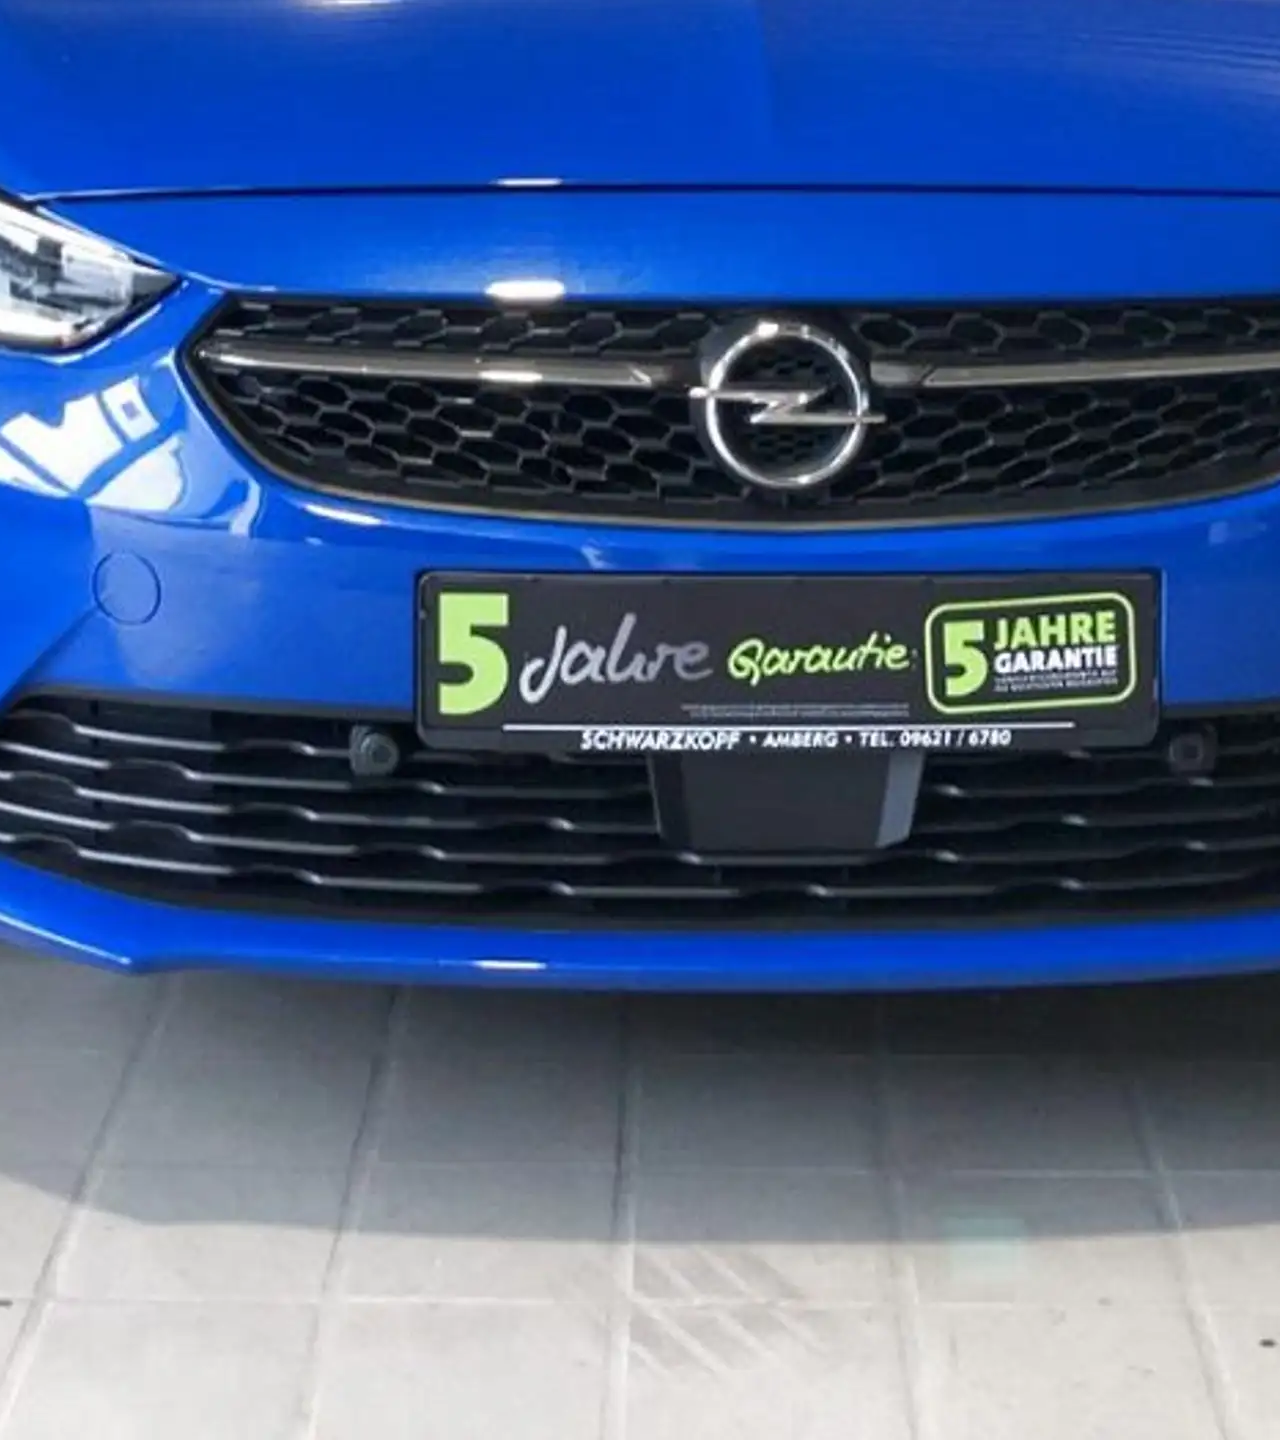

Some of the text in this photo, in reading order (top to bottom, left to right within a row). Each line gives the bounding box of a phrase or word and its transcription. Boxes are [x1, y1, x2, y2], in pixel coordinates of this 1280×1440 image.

[438, 593, 510, 714] 5
[519, 612, 714, 704] Jahre
[943, 610, 1117, 698] 5 JAHRE
[993, 645, 1119, 675] GARANTIE
[579, 730, 741, 751] SCHWARZKOPF
[762, 730, 838, 748] AMBERG
[859, 730, 895, 748] TEL.
[899, 729, 953, 747] 09621
[969, 729, 1012, 746] 6780
